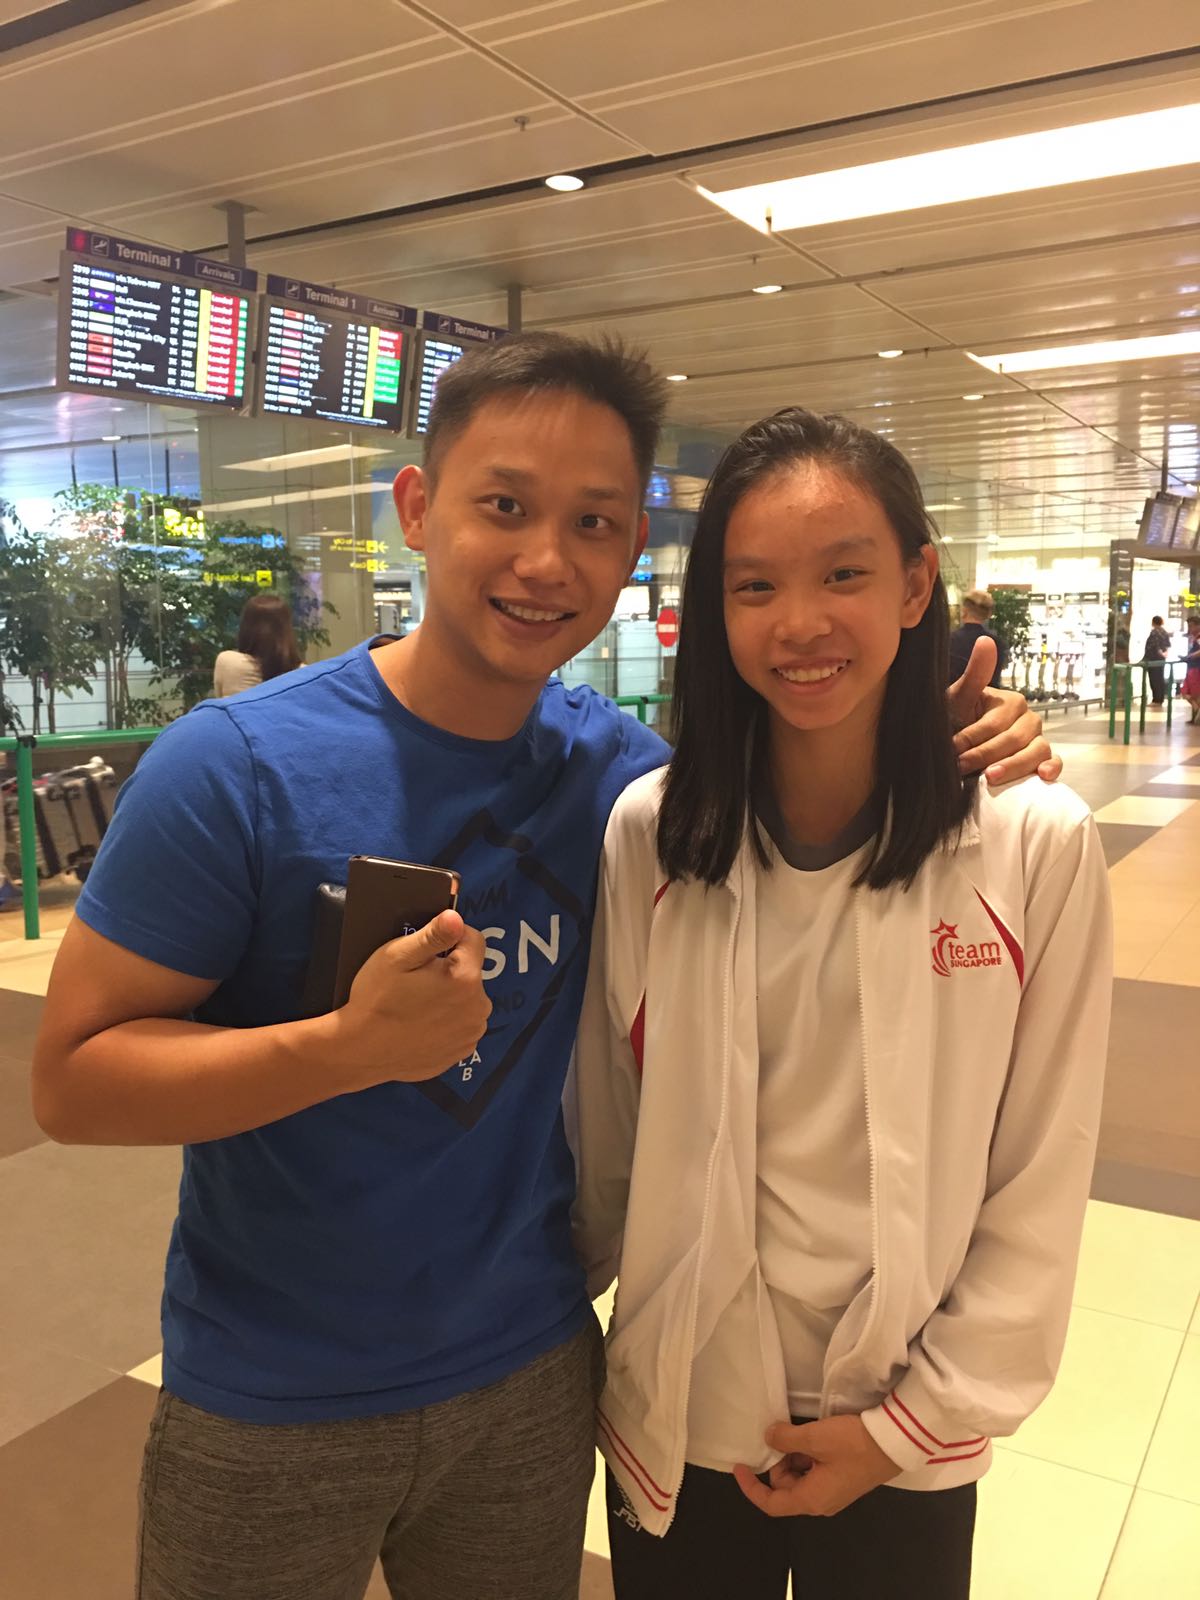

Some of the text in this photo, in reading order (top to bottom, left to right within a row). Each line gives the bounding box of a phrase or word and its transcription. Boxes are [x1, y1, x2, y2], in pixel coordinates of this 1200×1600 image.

[116, 243, 181, 270] Terminal 1
[202, 265, 235, 281] Arrivals
[305, 287, 357, 309] Terminal 1
[373, 304, 399, 318] Arrivals
[454, 322, 488, 340] Terminal
[948, 941, 1001, 960] team
[950, 957, 1003, 968] SINGAPORE
